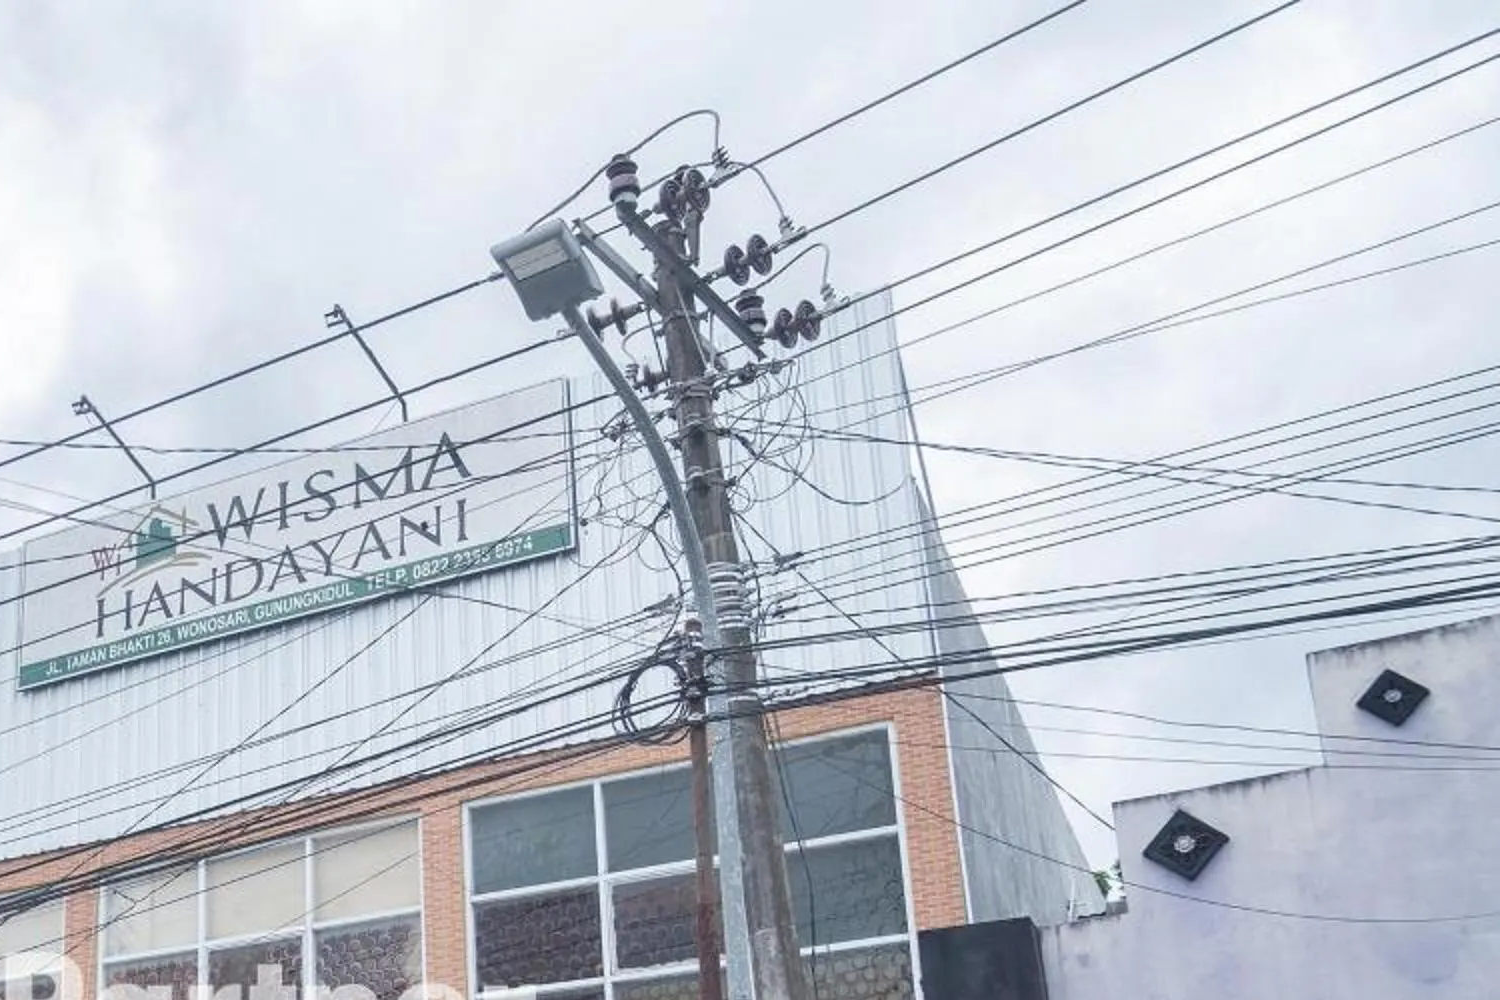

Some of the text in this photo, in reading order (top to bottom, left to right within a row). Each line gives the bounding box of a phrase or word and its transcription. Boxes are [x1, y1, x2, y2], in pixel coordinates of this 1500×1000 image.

[207, 431, 471, 549] WISMA
[46, 662, 62, 675] JL.
[65, 648, 106, 670] TAMAN
[110, 635, 154, 659] BHAKTI
[177, 612, 251, 639] WONOSARI,
[255, 583, 354, 619] GUNUNGKIDUL
[414, 557, 449, 578] 0822
[95, 499, 468, 637] HANDAYANI
